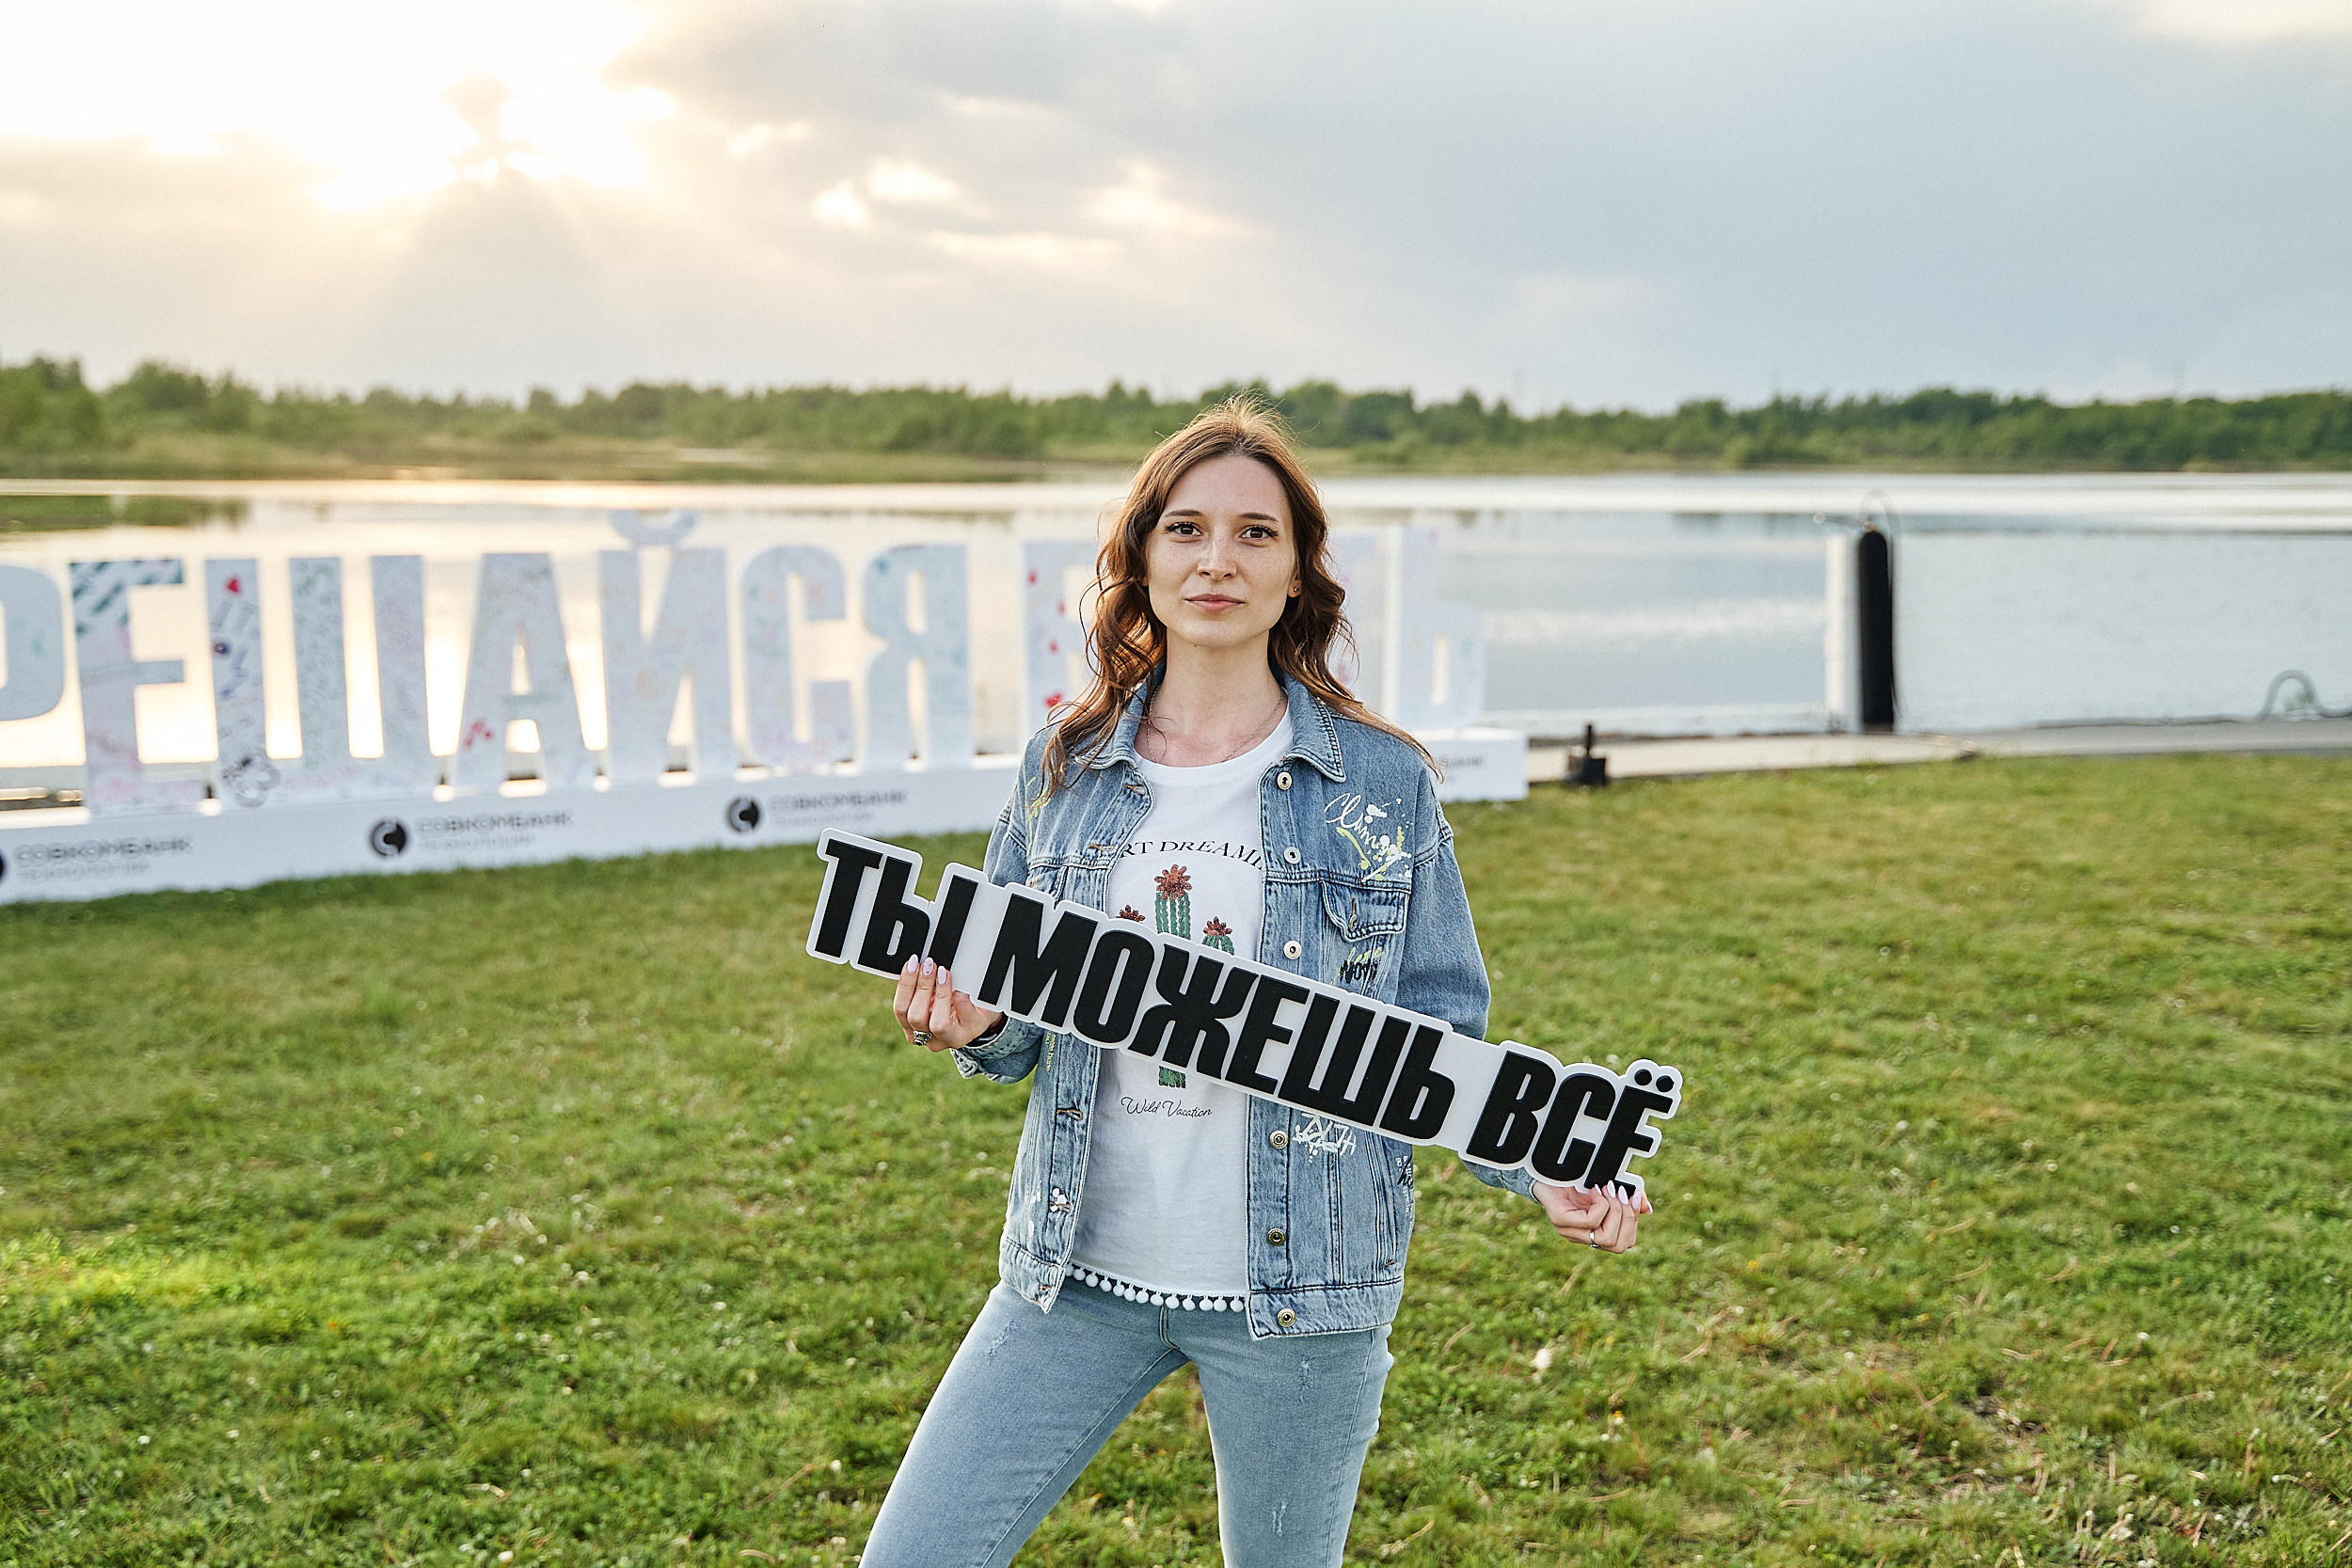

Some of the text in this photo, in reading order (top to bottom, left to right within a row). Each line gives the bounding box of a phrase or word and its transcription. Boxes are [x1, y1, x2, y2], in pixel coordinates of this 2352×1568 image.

[1159, 840, 1263, 871] DREAMI
[815, 838, 979, 975] ТЫ
[977, 894, 1455, 1140] МОЖЕШЬ
[1466, 1051, 1675, 1197] ВСЁ
[1120, 1096, 1214, 1118] Wild Vacation
